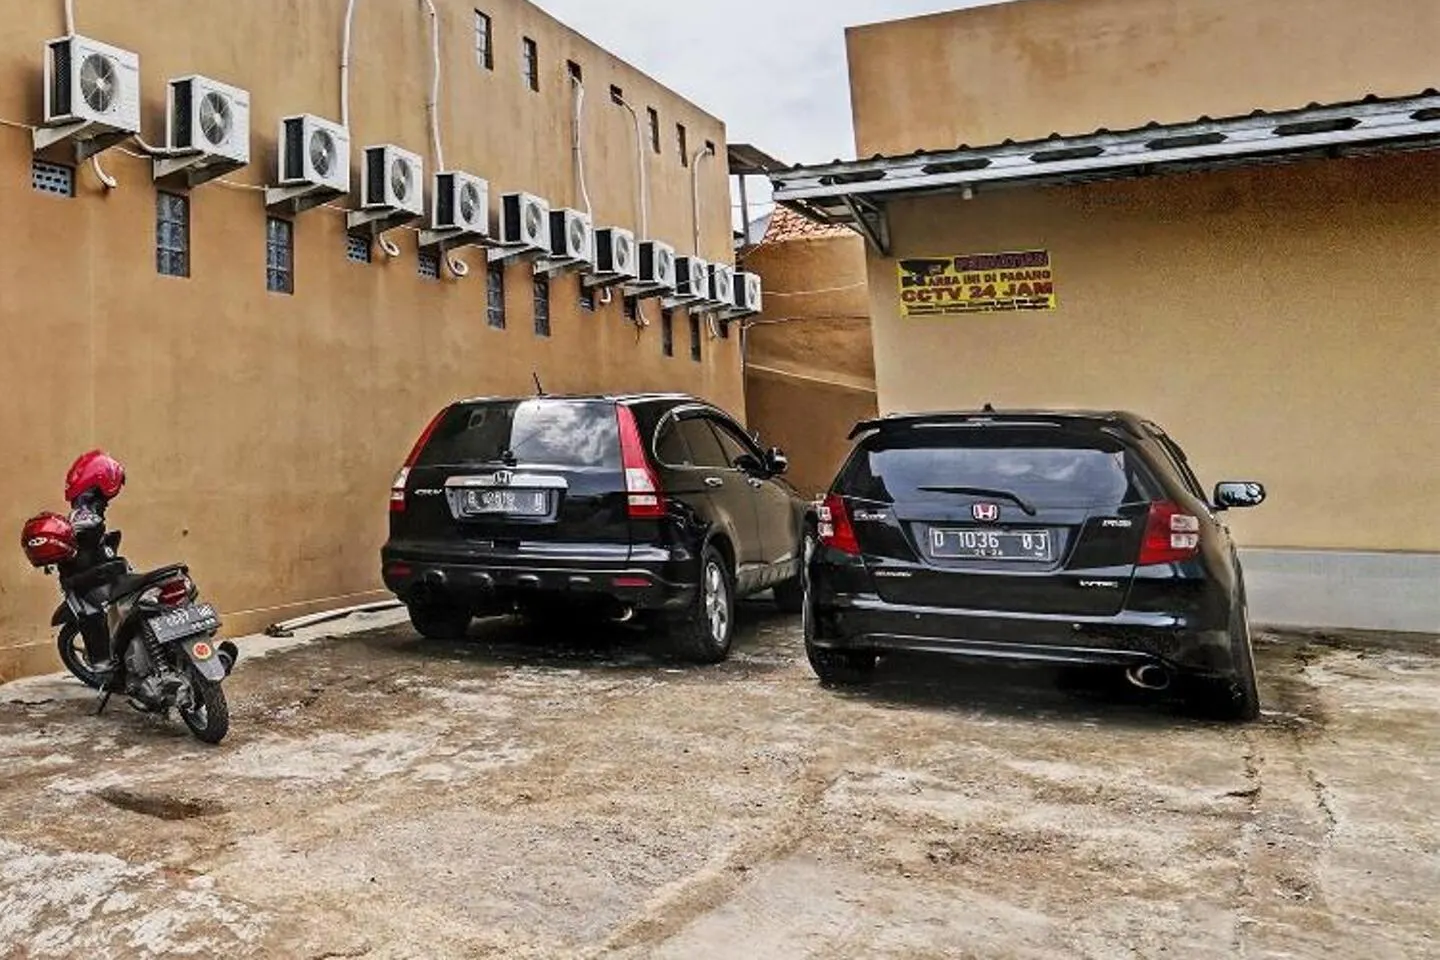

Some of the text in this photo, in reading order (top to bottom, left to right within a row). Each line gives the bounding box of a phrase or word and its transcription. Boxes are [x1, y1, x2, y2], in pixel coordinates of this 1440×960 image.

[984, 273, 998, 283] DI
[901, 282, 1053, 302] CCTV 24 JAM
[959, 531, 1000, 548] 1036
